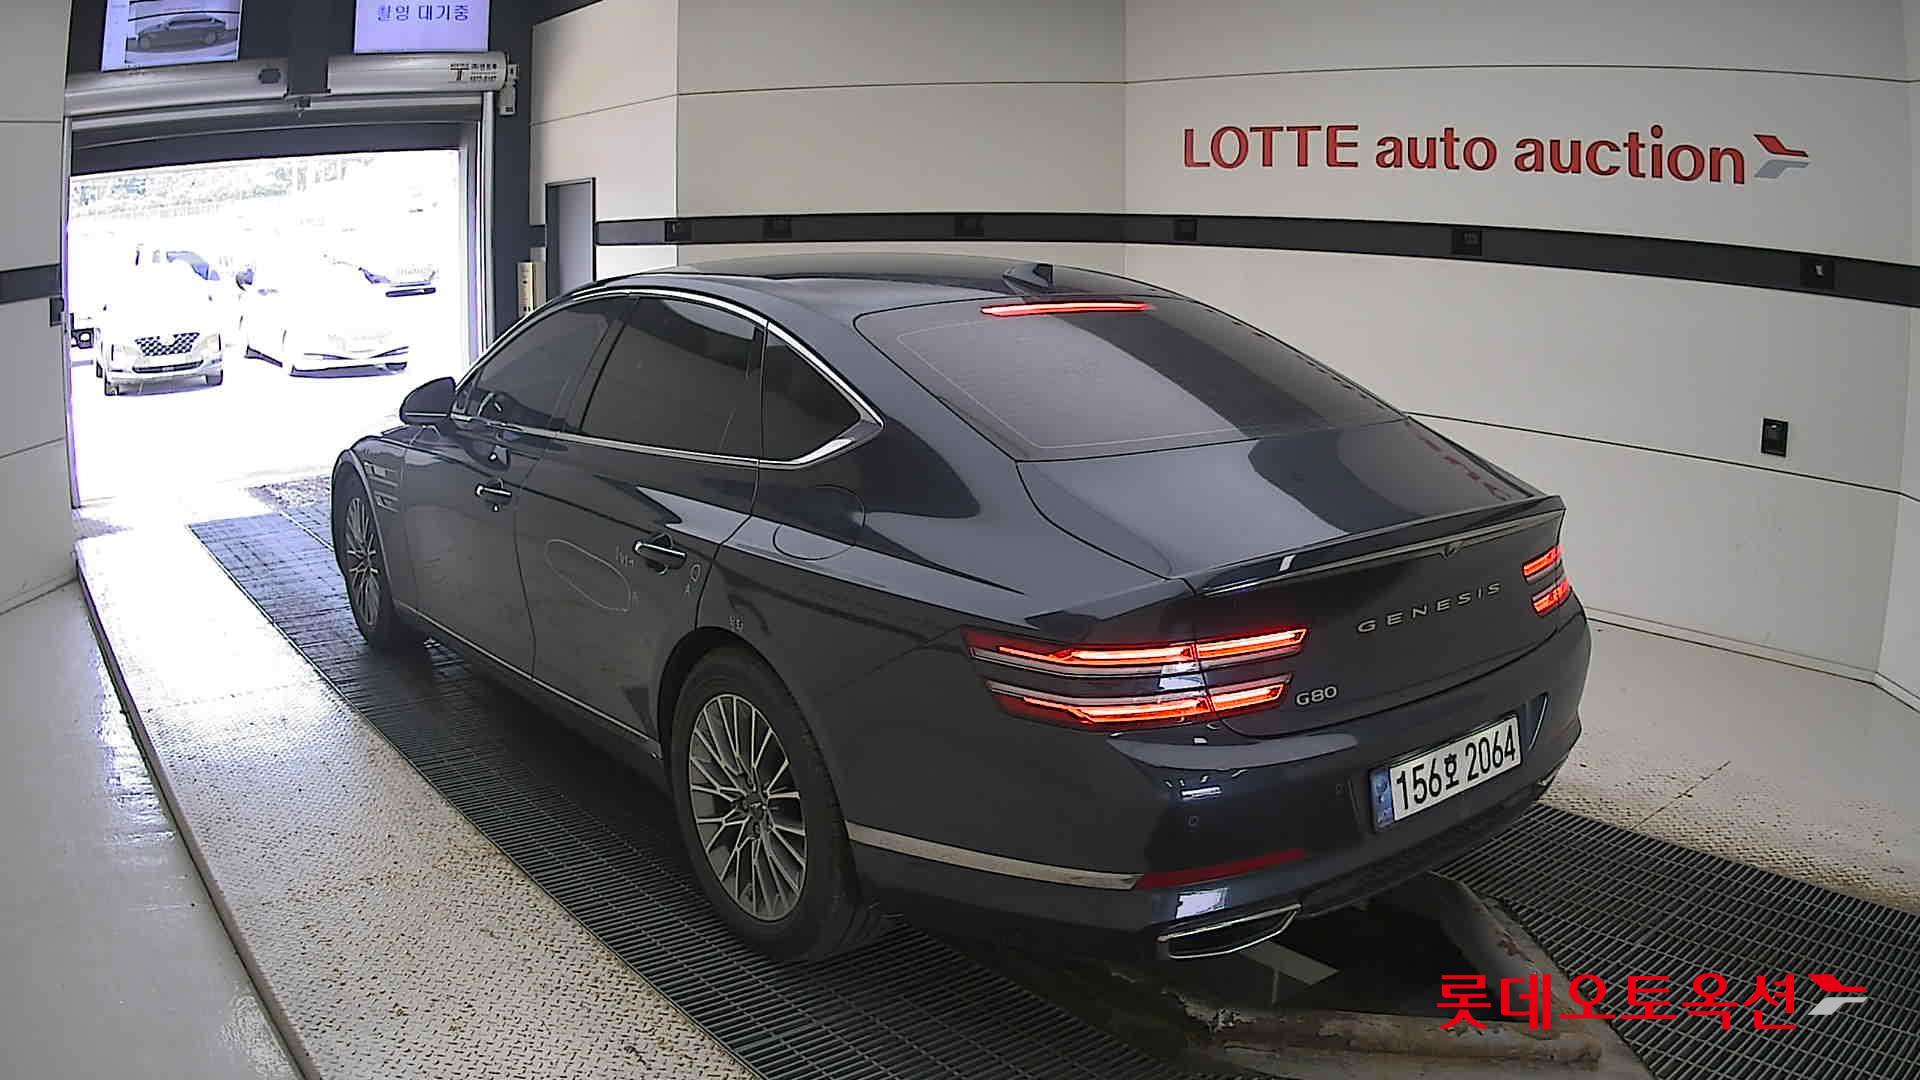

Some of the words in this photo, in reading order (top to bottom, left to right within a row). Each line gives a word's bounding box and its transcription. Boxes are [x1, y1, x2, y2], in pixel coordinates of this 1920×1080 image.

[418, 4, 469, 21] 대기중
[1183, 123, 1360, 171] LOTTE
[1375, 128, 1500, 171] auto
[1513, 125, 1746, 185] auction
[1357, 582, 1501, 633] GENESIS
[1295, 686, 1338, 706] G80
[1396, 753, 1460, 810] 156호
[1465, 724, 1516, 782] 2064
